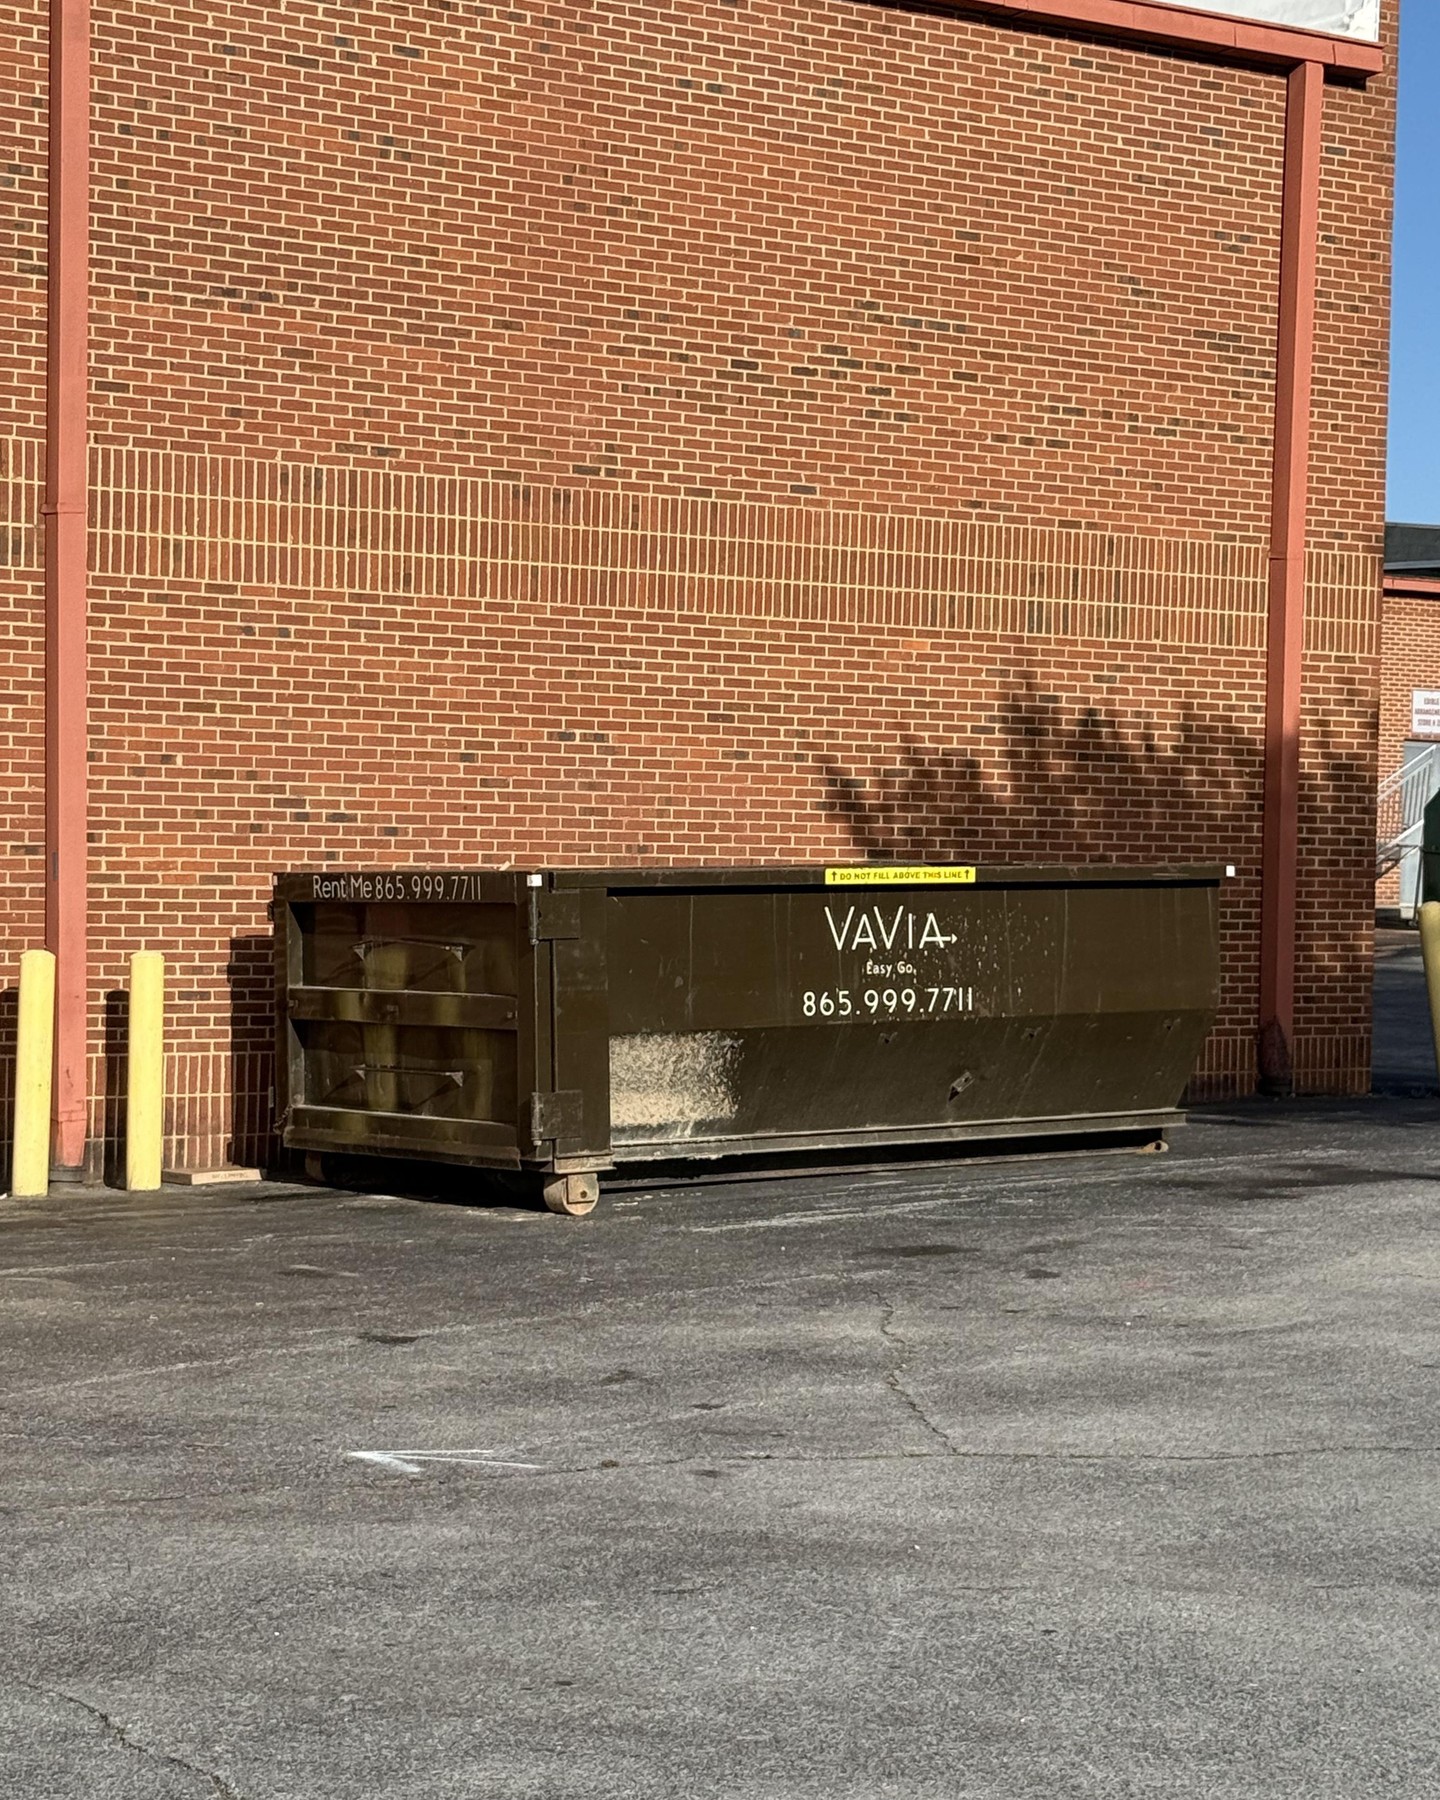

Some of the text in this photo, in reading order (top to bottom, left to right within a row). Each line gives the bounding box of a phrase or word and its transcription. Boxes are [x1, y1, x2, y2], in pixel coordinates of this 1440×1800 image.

[840, 871, 962, 881] DO NOT FILL ABOVE THIS LINE
[313, 875, 482, 900] Rent Me 865.999.7711
[866, 960, 893, 978] Easy
[802, 987, 973, 1017] 865.999.7711
